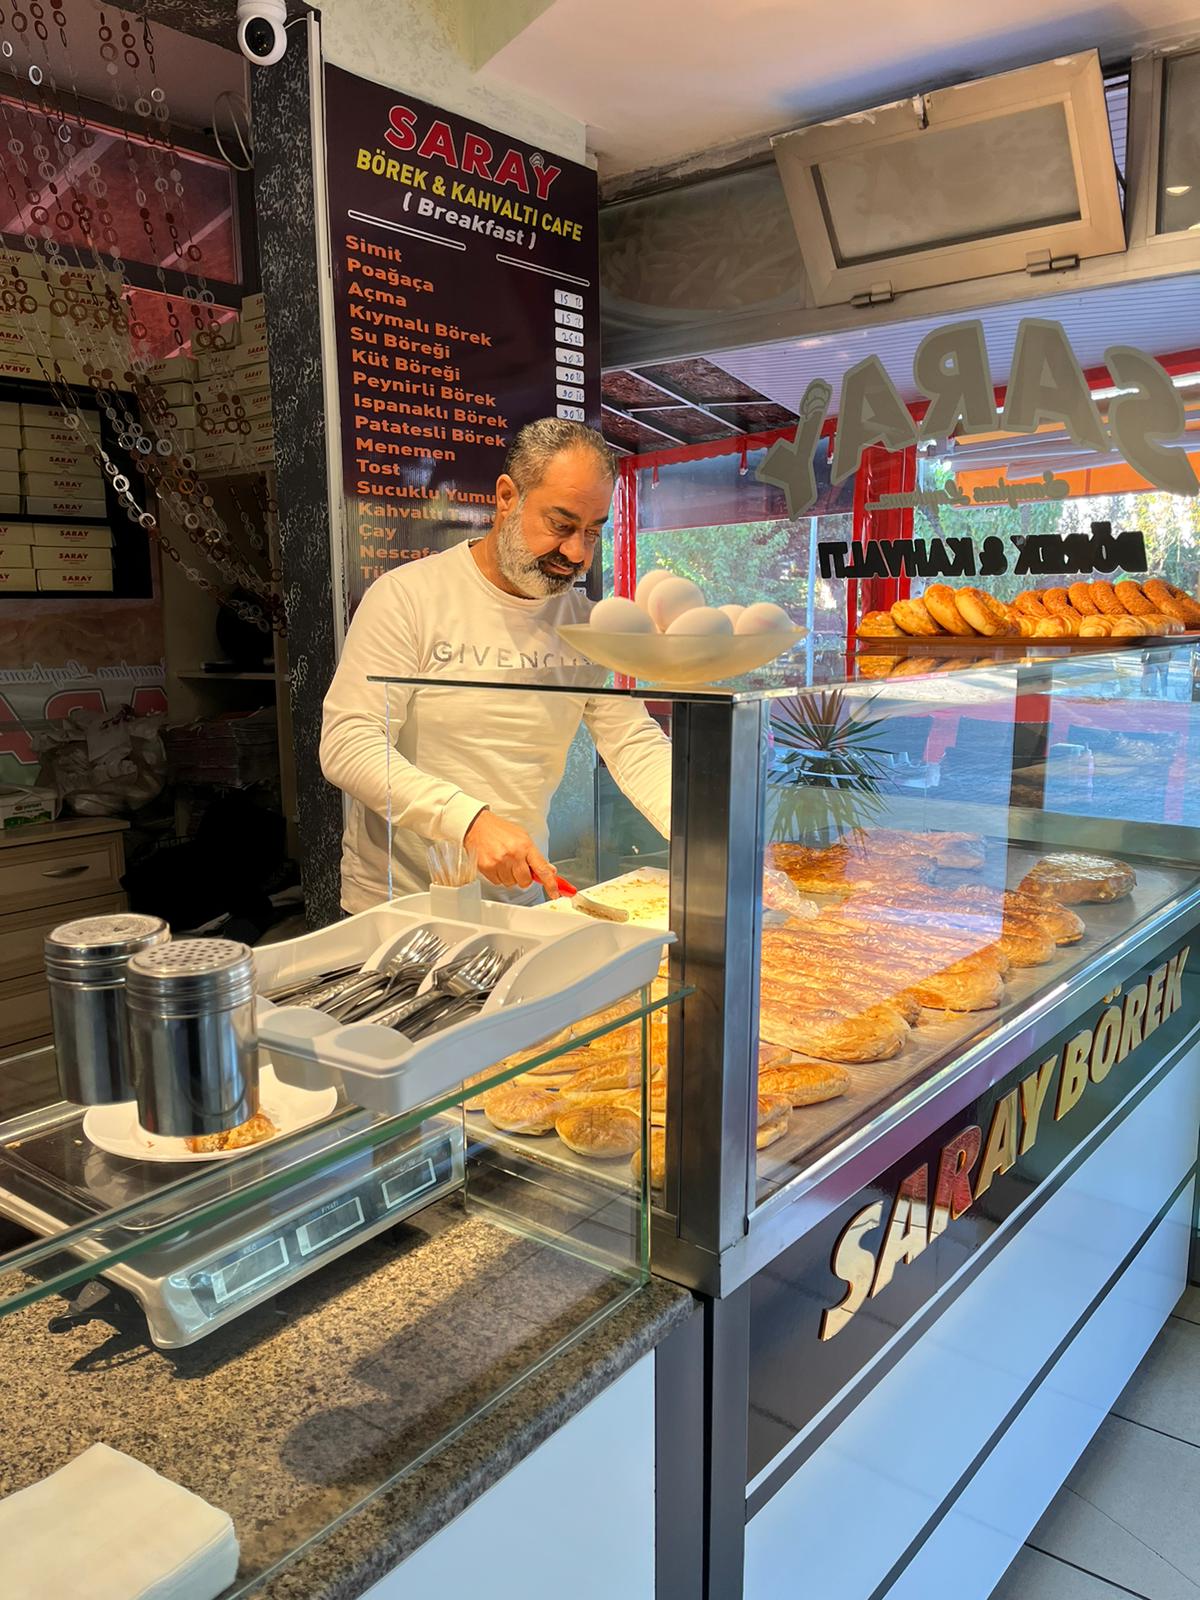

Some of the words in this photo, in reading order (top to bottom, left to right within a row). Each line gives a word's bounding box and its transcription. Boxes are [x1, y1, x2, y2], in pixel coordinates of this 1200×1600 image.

[384, 105, 562, 200] SARAY
[356, 148, 430, 190] BÖREK
[432, 175, 446, 197] &
[451, 181, 538, 226] KAHVALTI
[541, 213, 584, 241] CAFE
[417, 197, 524, 245] Breakfast
[345, 235, 402, 262] Simit
[347, 258, 434, 292] Poağaça
[348, 282, 407, 307] Açma
[349, 303, 430, 334] Kıymalı
[434, 322, 492, 347] Börek
[350, 327, 378, 344] Su
[383, 333, 450, 360] Böreği
[352, 349, 389, 369] Küt
[394, 357, 460, 382] Böreği
[352, 371, 435, 397] Peynirli
[440, 386, 496, 407] Börek
[354, 393, 449, 420] Ispanaklı
[453, 408, 508, 429] Börek
[355, 415, 447, 440] Patatesli
[451, 428, 506, 448] Börek
[49, 456, 78, 464] SARAY
[356, 437, 456, 461] Menemen
[356, 458, 400, 476] Tost
[53, 480, 83, 488] SARAY
[357, 480, 440, 499] Sucuklu
[445, 487, 497, 505] Yumu
[53, 503, 82, 511] SARAY
[359, 502, 442, 519] Kahvaltı
[60, 529, 89, 537] SARAY
[359, 523, 397, 540] Çay
[59, 552, 88, 560] SARAY
[62, 575, 93, 583] SARAY
[817, 1055, 1058, 1342] SARAY
[1053, 945, 1192, 1122] BÖREK
